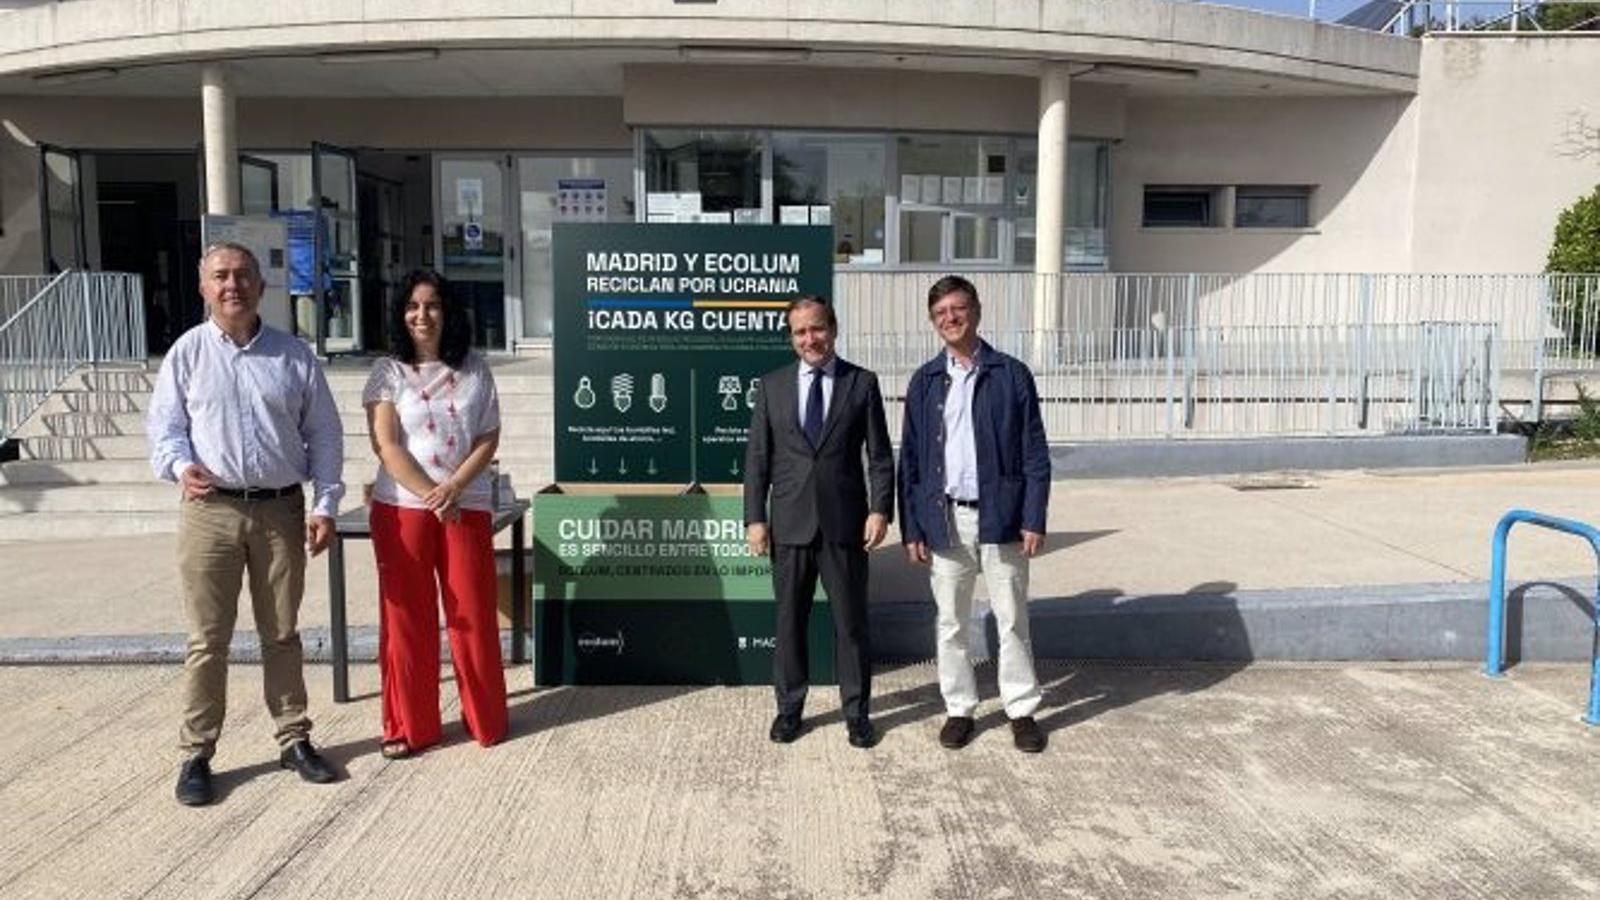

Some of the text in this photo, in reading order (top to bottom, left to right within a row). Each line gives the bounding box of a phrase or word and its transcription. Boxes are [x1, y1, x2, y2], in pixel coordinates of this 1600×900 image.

[586, 252, 800, 273] MADRID Y ECOLUM
[586, 277, 799, 293] RECICLAN POR UCRANIA
[665, 310, 695, 330] KG
[558, 518, 748, 540] CUIDAR MADRI
[559, 543, 759, 557] ES SENCILLO ENTRE TODO
